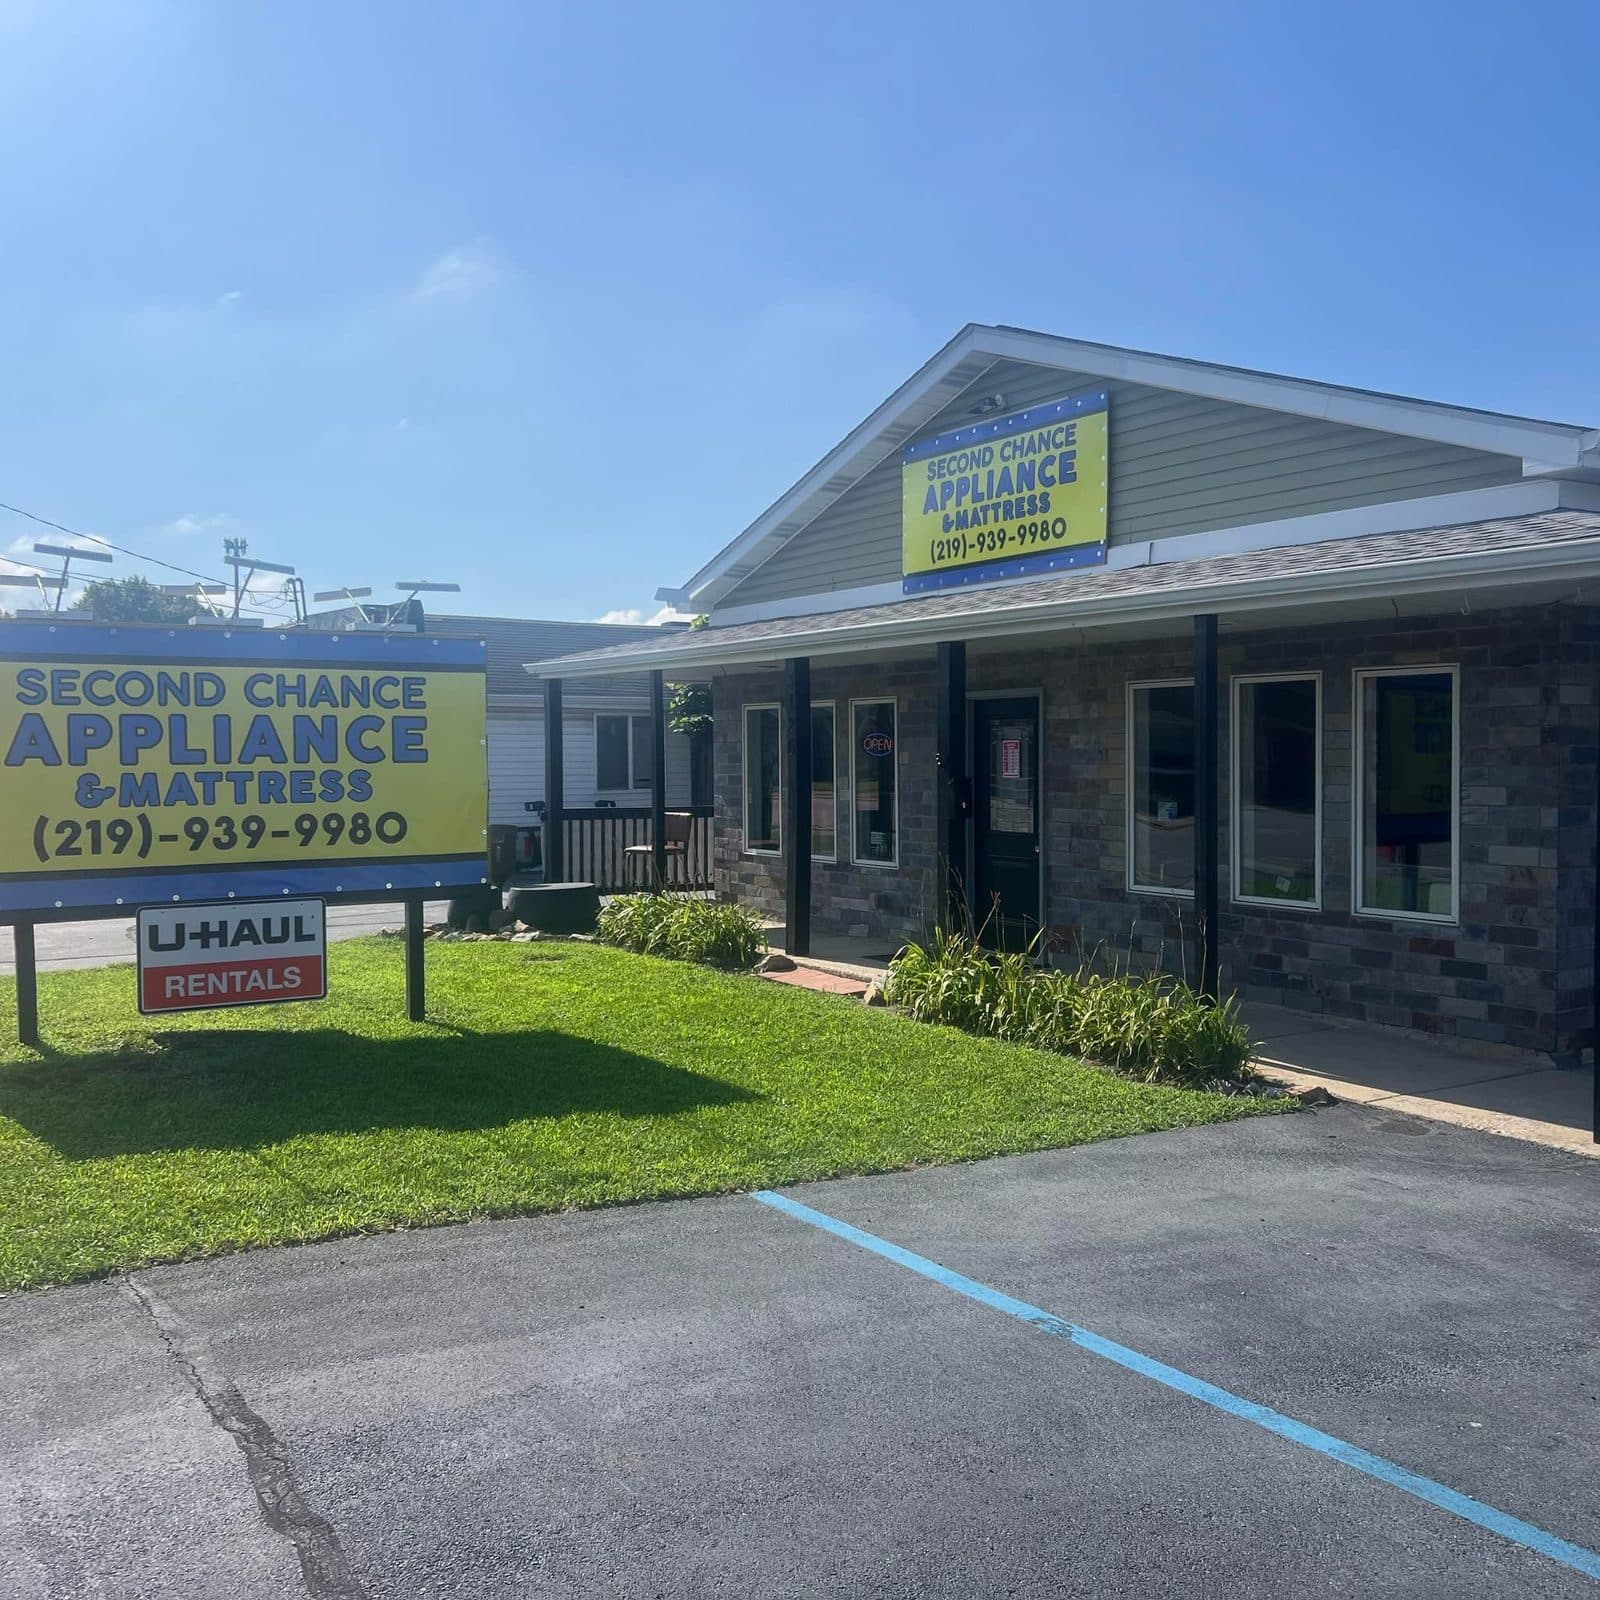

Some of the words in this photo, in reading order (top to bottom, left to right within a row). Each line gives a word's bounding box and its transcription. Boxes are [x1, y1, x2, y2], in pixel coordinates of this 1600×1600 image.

[927, 446, 994, 481] SECOND
[1000, 423, 1077, 462] CHANCE
[923, 450, 1077, 515] APPLIANCE
[942, 492, 1050, 533] &MATTRESS
[931, 517, 1067, 564] (219)-939-9980
[15, 668, 226, 707] SECOND
[244, 673, 427, 709] CHANCE
[4, 712, 429, 766] APPLIANCE
[863, 737, 892, 751] OPEN
[75, 769, 374, 808] &MATTRESS
[33, 811, 408, 863] (219)-939-9980
[148, 915, 316, 952] U-HAUL
[165, 966, 302, 998] RENTALS
